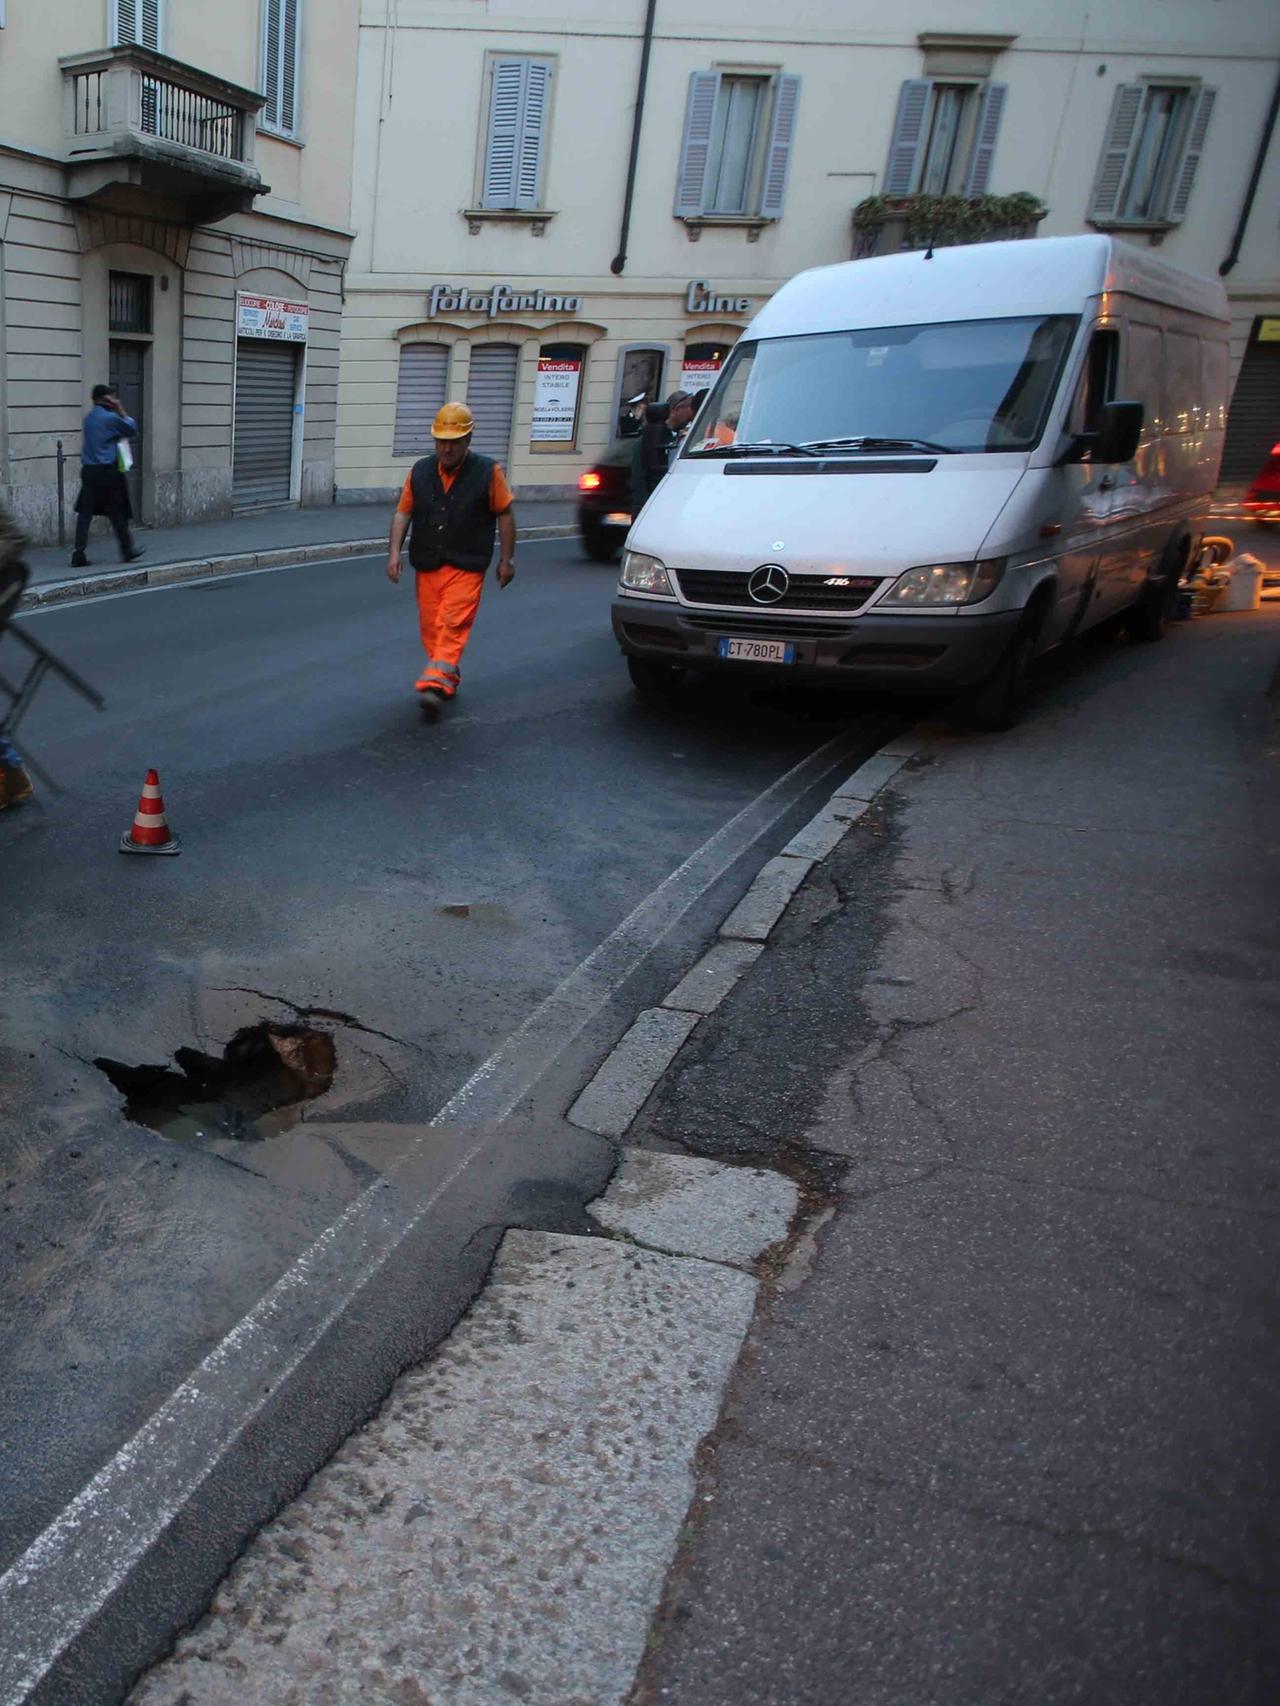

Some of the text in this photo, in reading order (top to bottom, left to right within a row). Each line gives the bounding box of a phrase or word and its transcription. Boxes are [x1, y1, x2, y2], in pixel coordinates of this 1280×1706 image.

[428, 284, 583, 319] fotofarina
[686, 280, 753, 313] Cine
[541, 363, 575, 371] Vendita
[684, 361, 716, 370] Vendita
